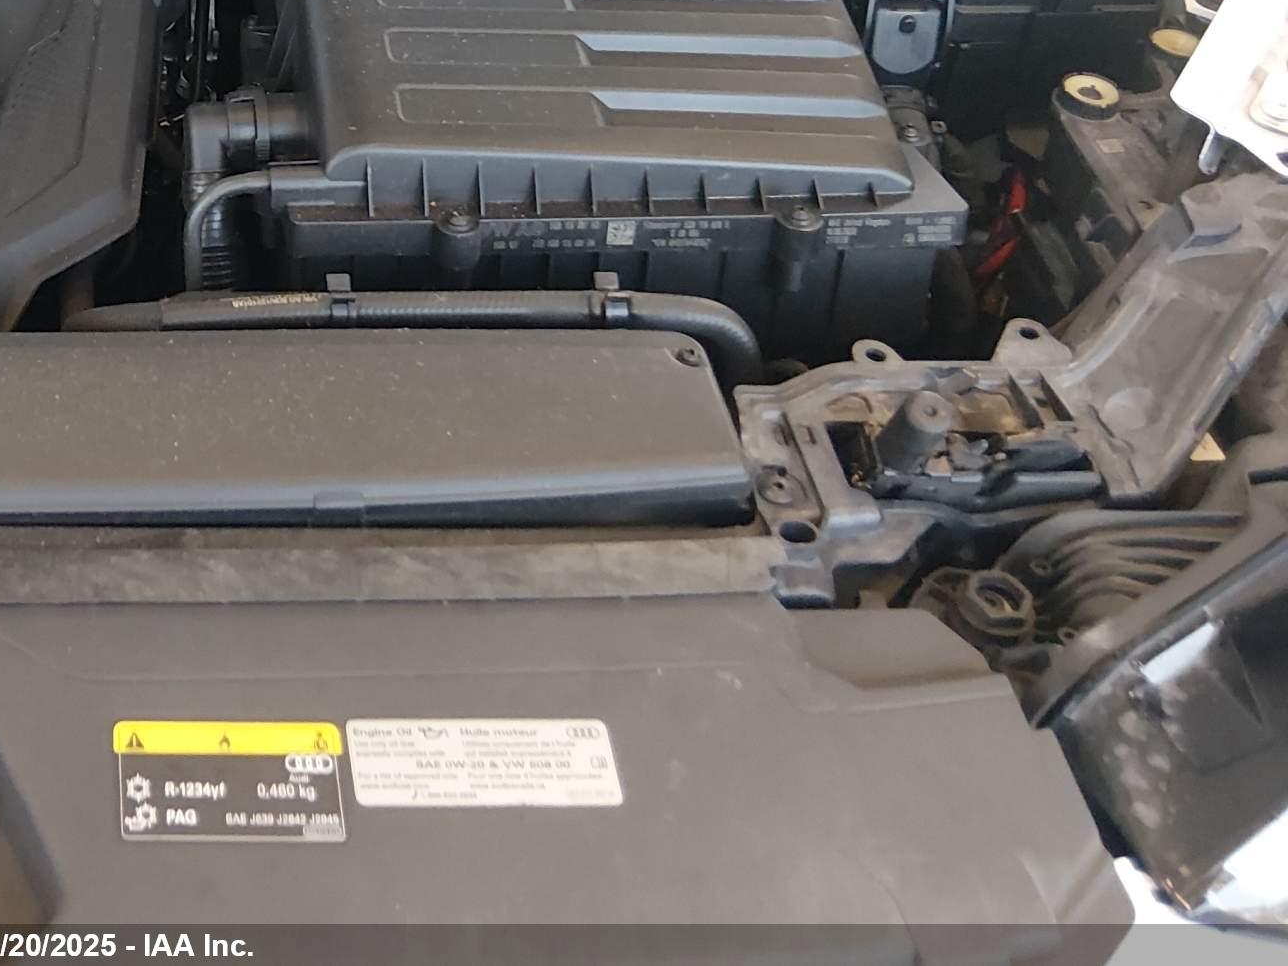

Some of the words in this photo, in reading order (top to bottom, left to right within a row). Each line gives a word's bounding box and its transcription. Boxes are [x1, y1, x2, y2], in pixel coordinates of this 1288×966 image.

[352, 726, 393, 739] Engine
[396, 726, 412, 738] Oil
[493, 726, 537, 738] moteur
[415, 759, 441, 770] SAE
[502, 759, 525, 770] VW
[299, 782, 316, 802] kg
[165, 808, 198, 826] PAG
[225, 812, 247, 826] SAE
